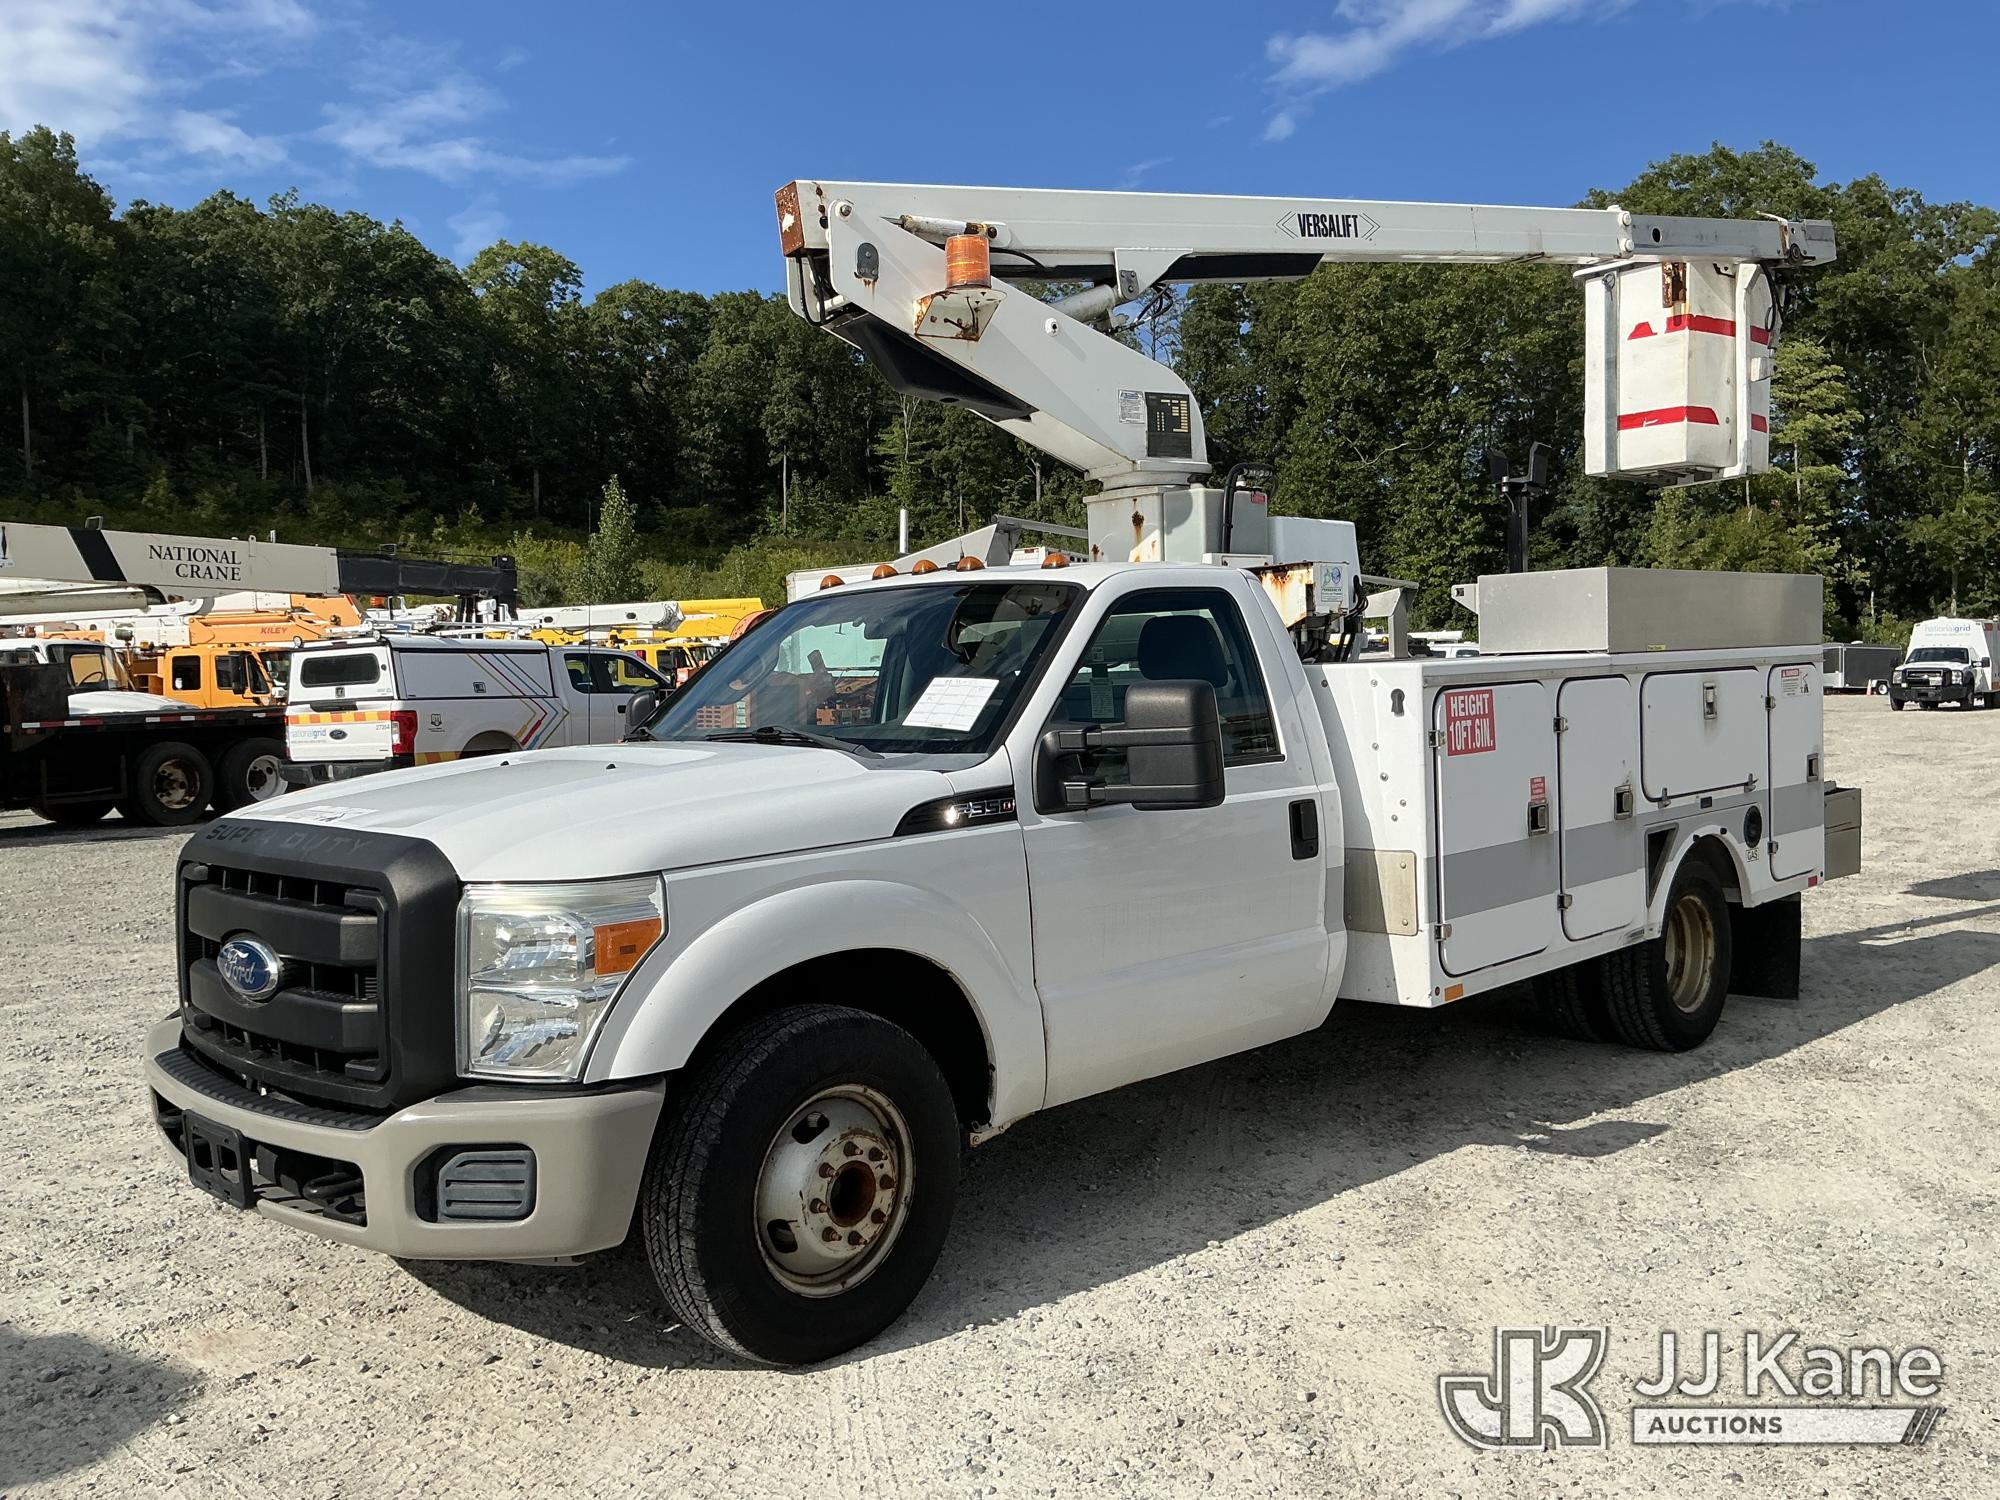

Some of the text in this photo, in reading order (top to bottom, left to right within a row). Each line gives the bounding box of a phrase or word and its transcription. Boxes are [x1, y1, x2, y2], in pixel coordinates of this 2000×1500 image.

[1297, 213, 1359, 238] VERSALIFT
[148, 545, 242, 565] NATIONAL
[175, 563, 241, 581] CRANE
[260, 626, 288, 634] KILEY
[1450, 693, 1489, 717] HEIGHT
